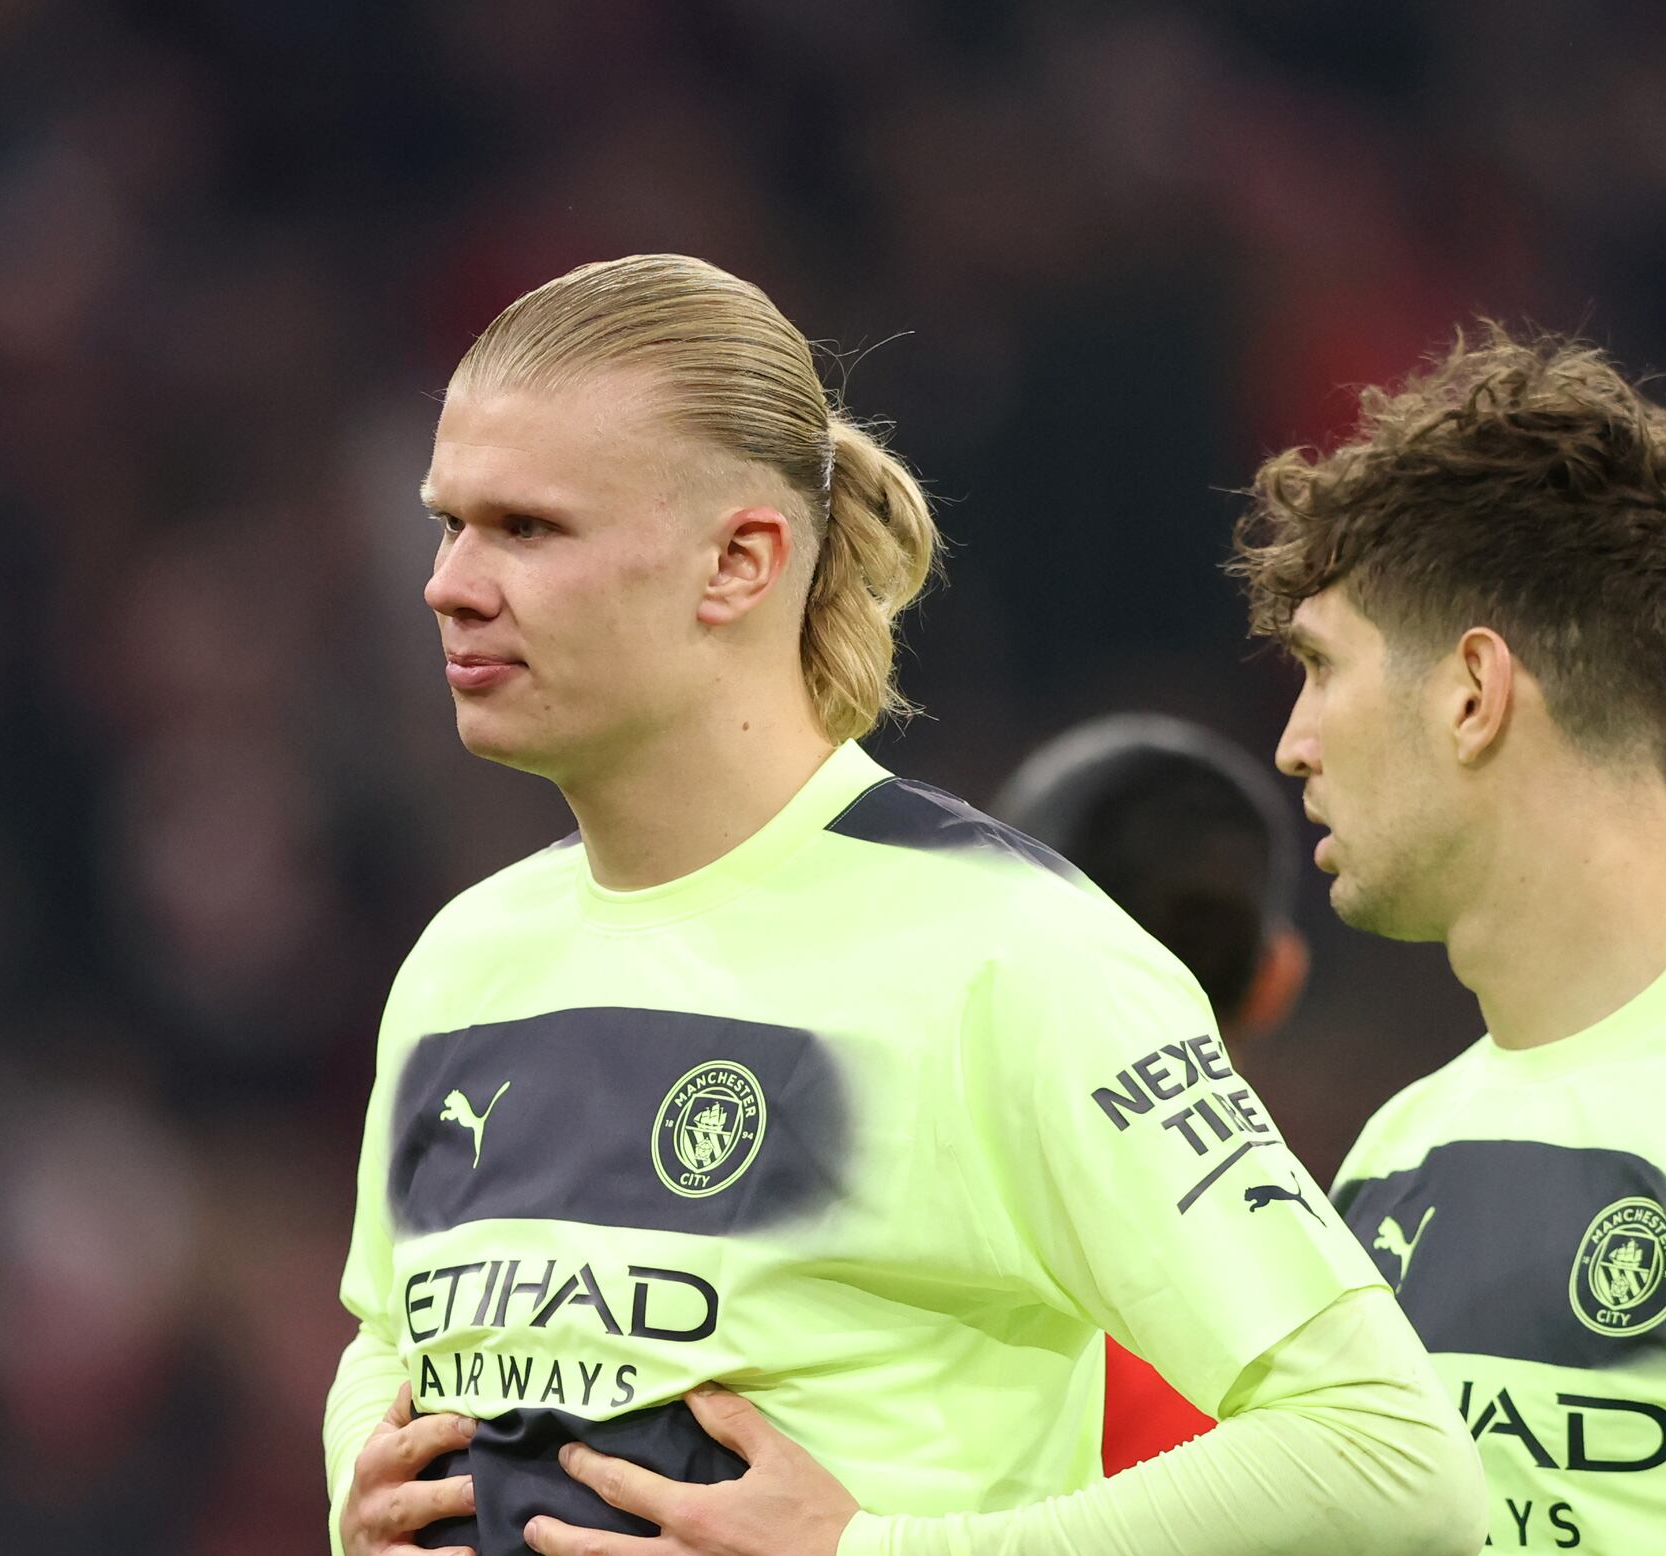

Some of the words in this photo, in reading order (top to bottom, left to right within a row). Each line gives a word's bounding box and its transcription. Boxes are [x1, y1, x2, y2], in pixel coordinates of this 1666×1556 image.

[674, 1071, 757, 1118] MANCHESTER
[1091, 1034, 1233, 1132] NEXE
[742, 1131, 754, 1140] 94
[680, 1173, 710, 1188] CITY
[405, 1260, 719, 1343] ETIHAD
[1596, 1310, 1631, 1326] CITY
[420, 1352, 637, 1408] AIRWAYS
